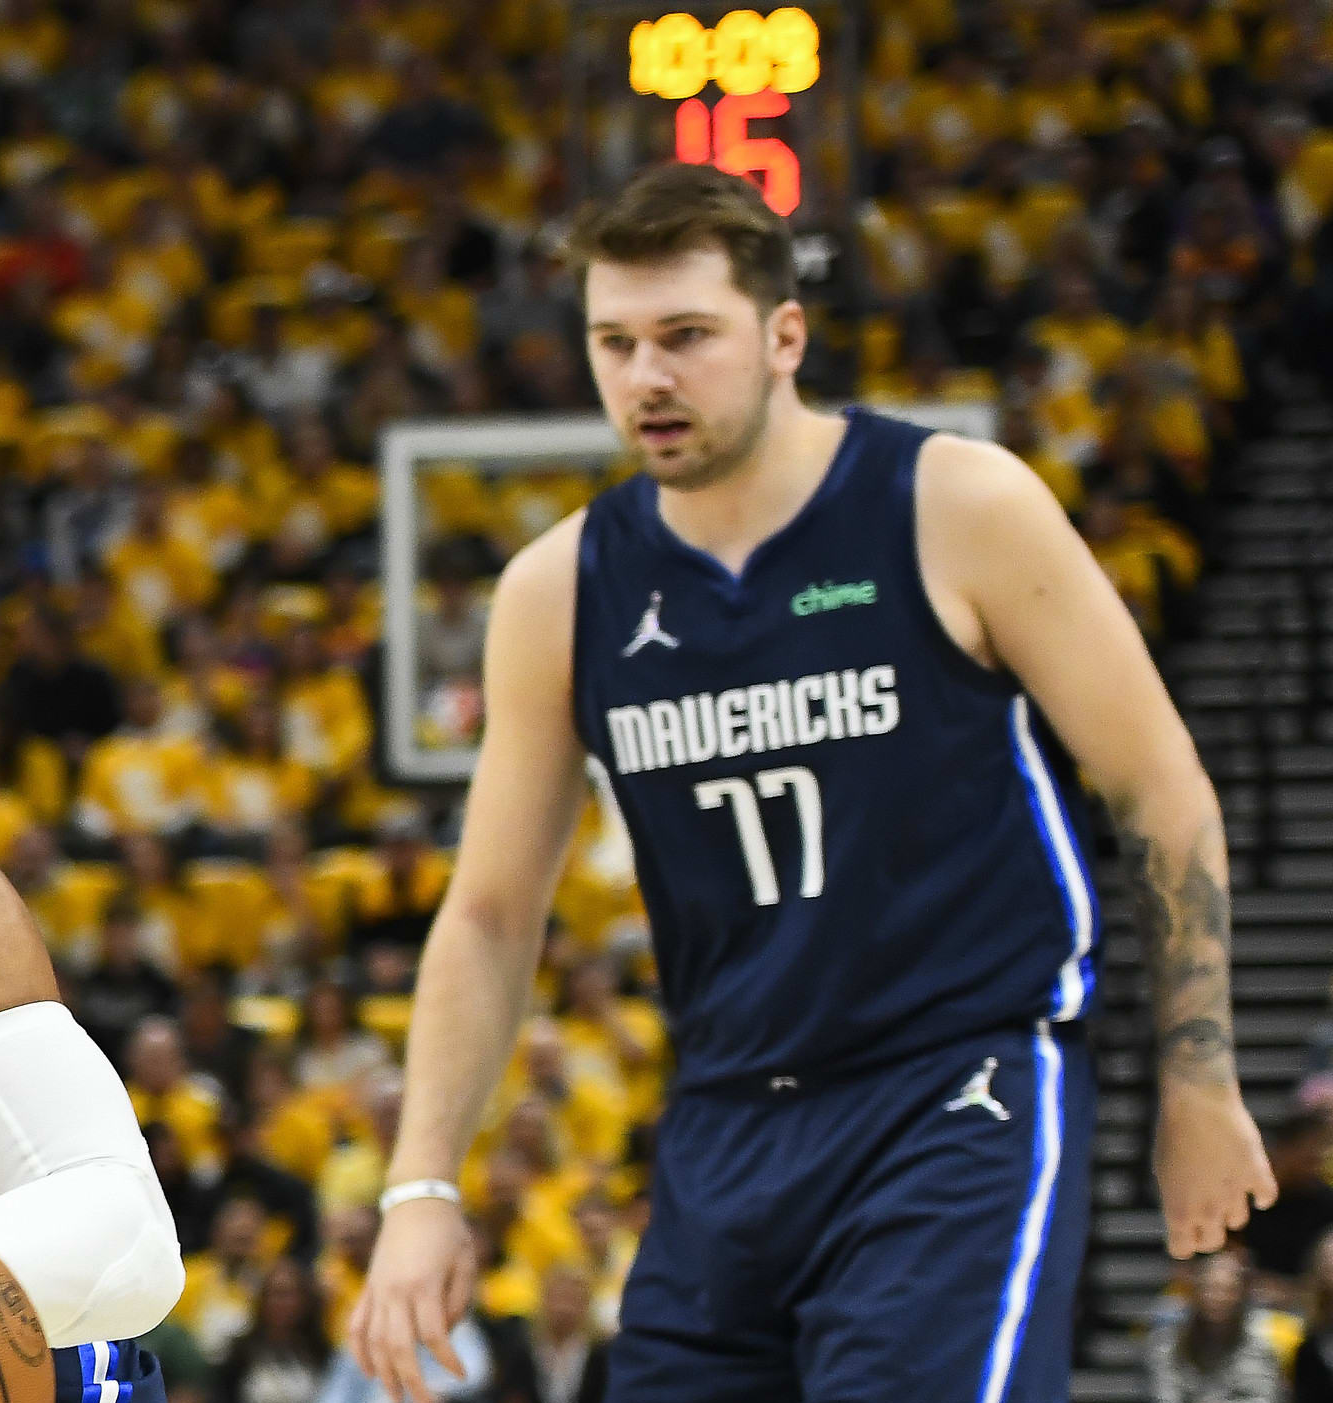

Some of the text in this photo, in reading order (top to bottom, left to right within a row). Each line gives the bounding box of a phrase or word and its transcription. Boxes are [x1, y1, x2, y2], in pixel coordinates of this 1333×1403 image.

[629, 7, 820, 99] 10:09
[606, 664, 901, 775] MAVERICKS
[694, 766, 825, 906] 77
